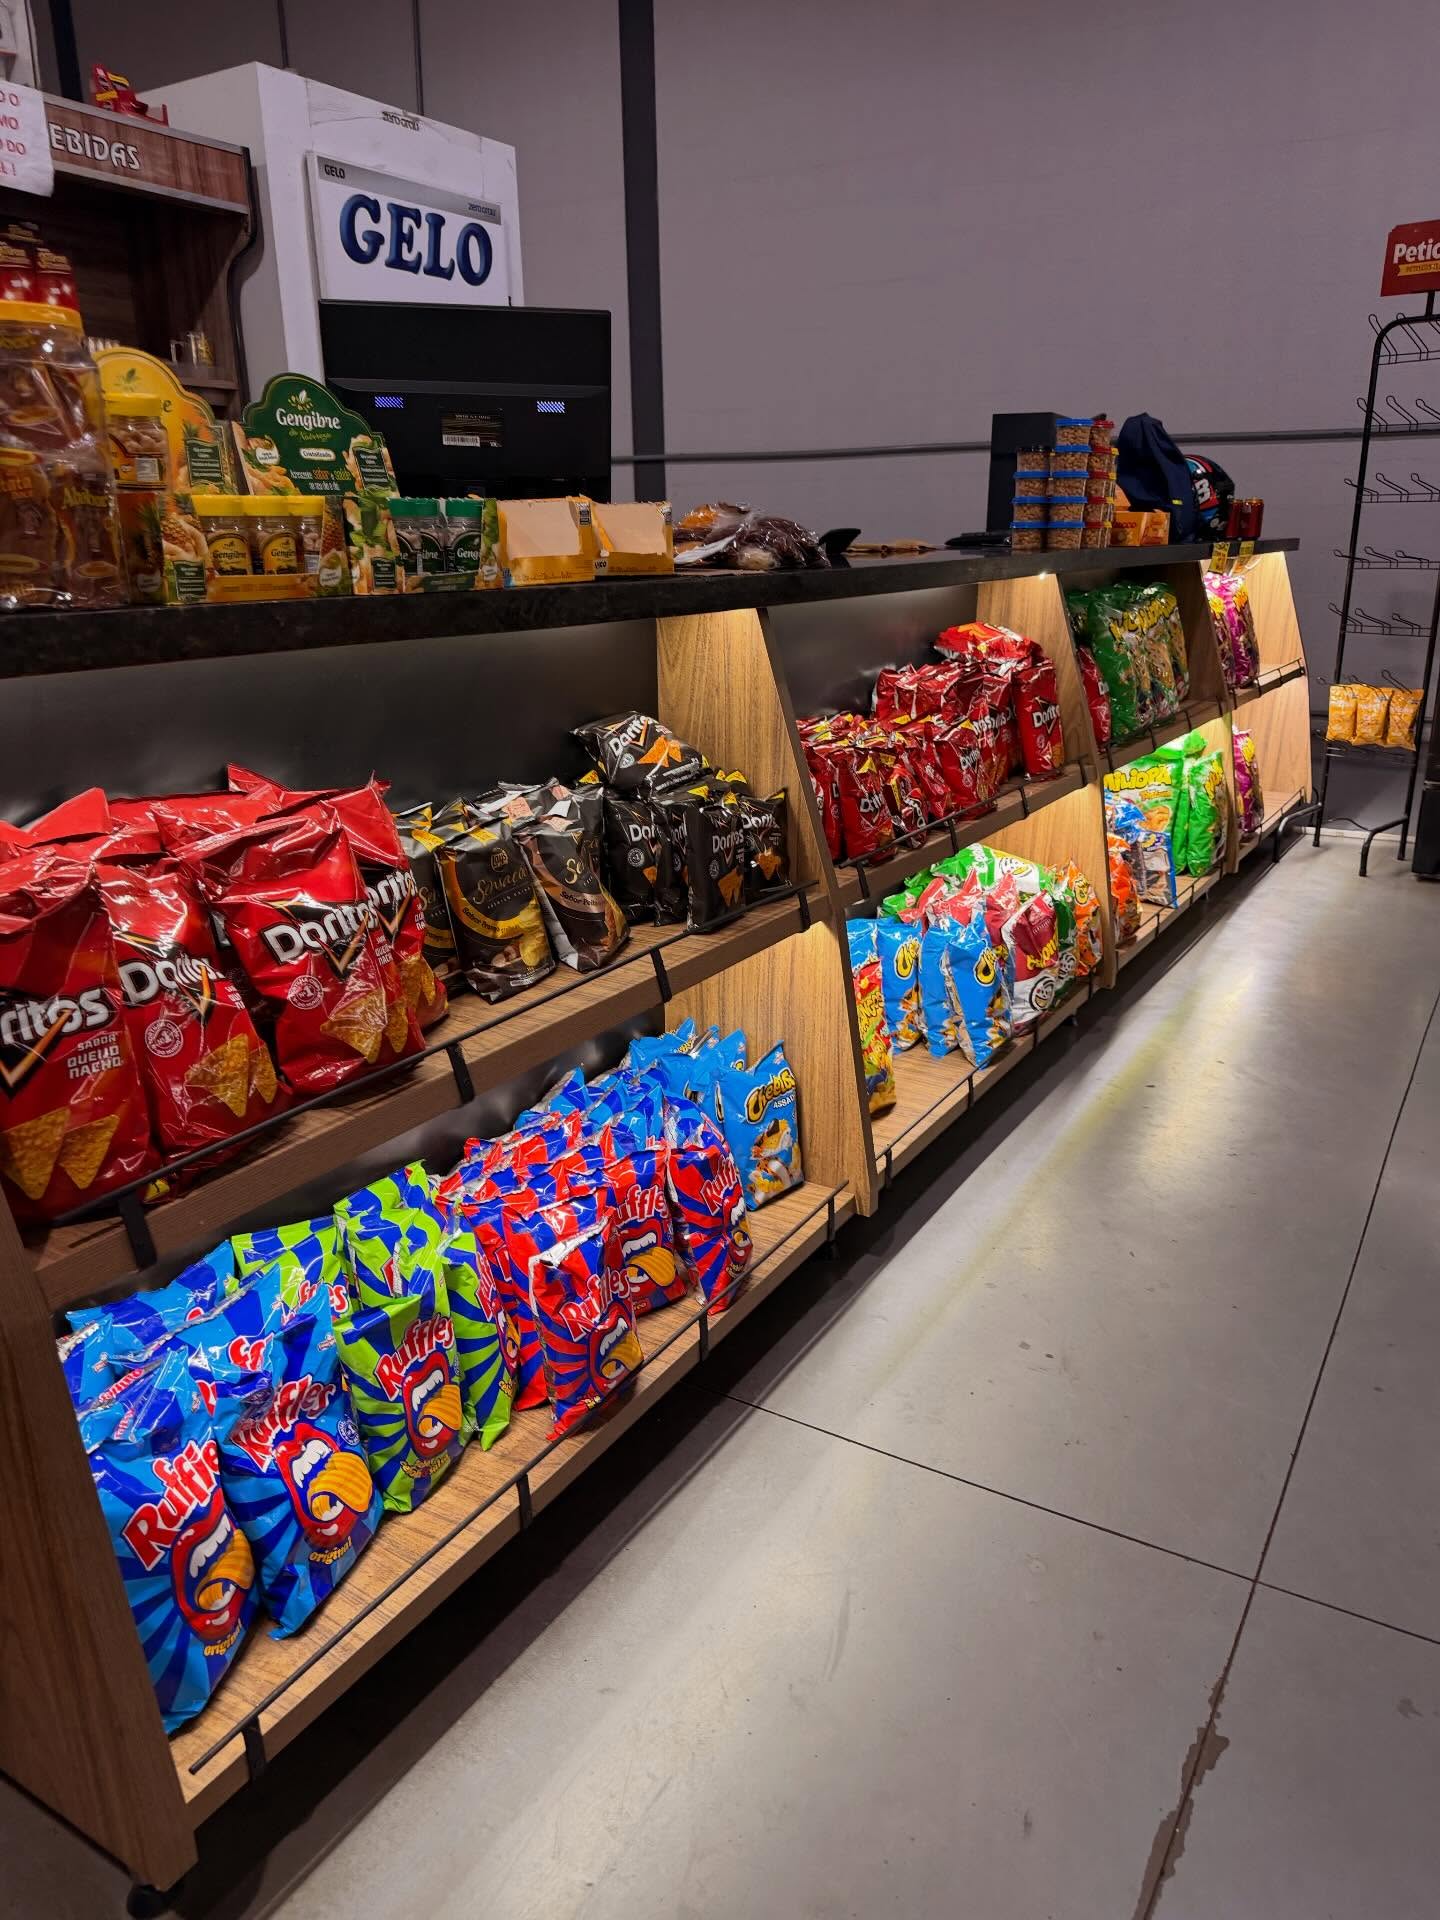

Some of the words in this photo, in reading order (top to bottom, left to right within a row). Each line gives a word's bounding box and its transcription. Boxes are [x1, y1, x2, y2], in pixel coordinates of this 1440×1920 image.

[324, 164, 345, 179] GELO
[338, 193, 493, 286] GELO
[275, 408, 341, 431] Gengibre
[262, 902, 380, 964] Doritos
[0, 987, 109, 1046] ritos
[67, 1045, 119, 1068] QUEIJO
[77, 1032, 118, 1051] SABOR
[69, 1057, 123, 1079] NACHO
[373, 1313, 456, 1402] Ruffles
[229, 1373, 337, 1474] Ruffles
[309, 1535, 354, 1565] original
[203, 1617, 245, 1658] original
